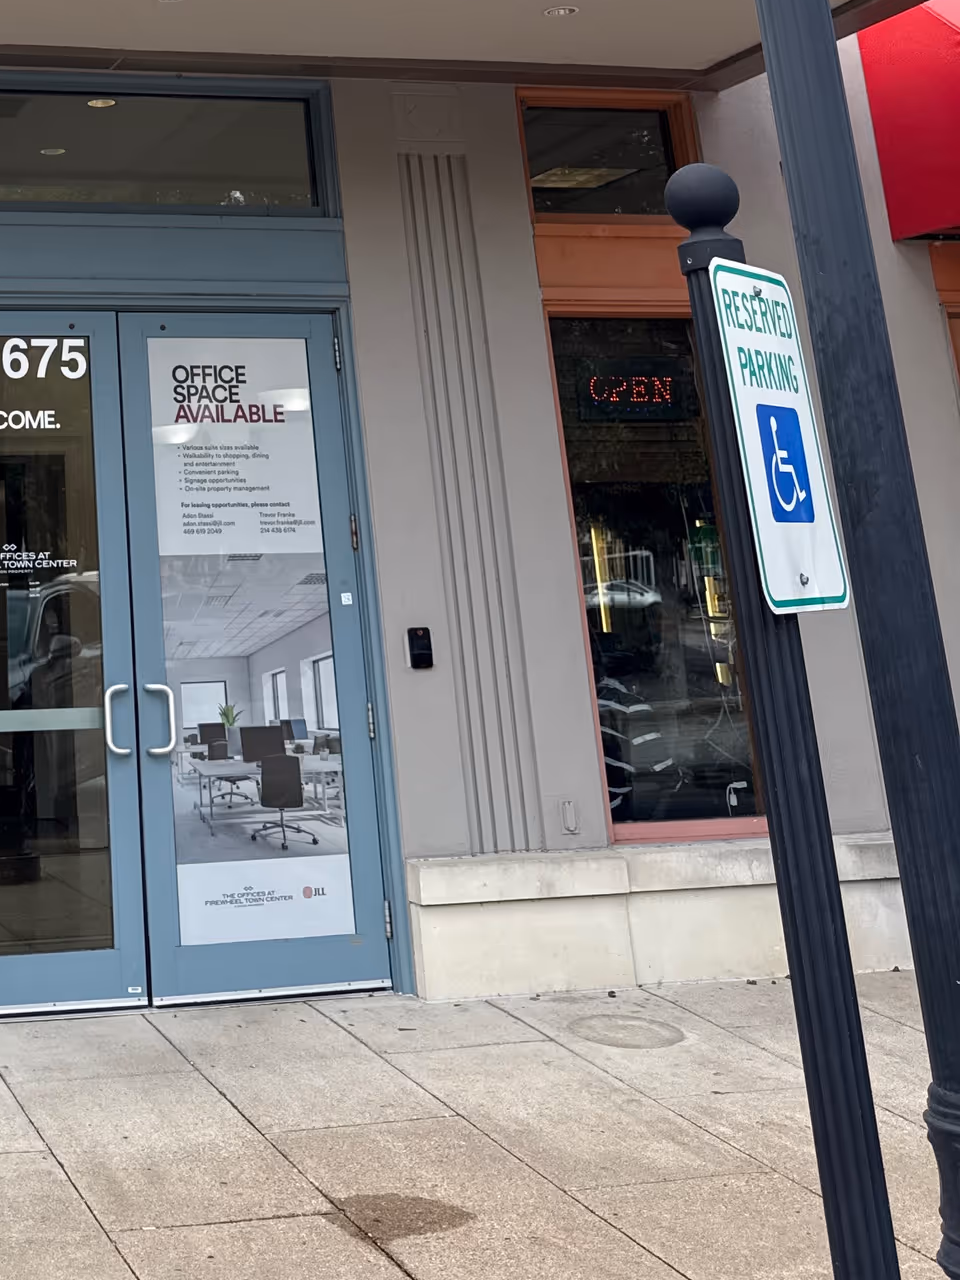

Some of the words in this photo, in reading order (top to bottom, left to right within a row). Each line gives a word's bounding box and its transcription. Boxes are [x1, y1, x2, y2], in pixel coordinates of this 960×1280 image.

[721, 287, 793, 340] RESERVED
[2, 337, 87, 380] 675
[171, 364, 247, 384] OFFICE
[736, 345, 800, 395] PARKING
[173, 384, 240, 404] SPACE
[589, 376, 673, 402] OPEN
[174, 404, 286, 424] AVAILABLE
[182, 452, 214, 460] Walkability
[222, 452, 250, 460] shopping,
[251, 452, 270, 460] dining
[184, 477, 207, 485] Signage
[37, 551, 51, 560] AT
[2, 560, 34, 569] TOWN
[34, 559, 78, 568] CENTER
[237, 890, 266, 899] OFFICES
[313, 887, 327, 897] JLL
[204, 898, 244, 906] FIREWHEEL
[265, 895, 294, 903] CENTER
